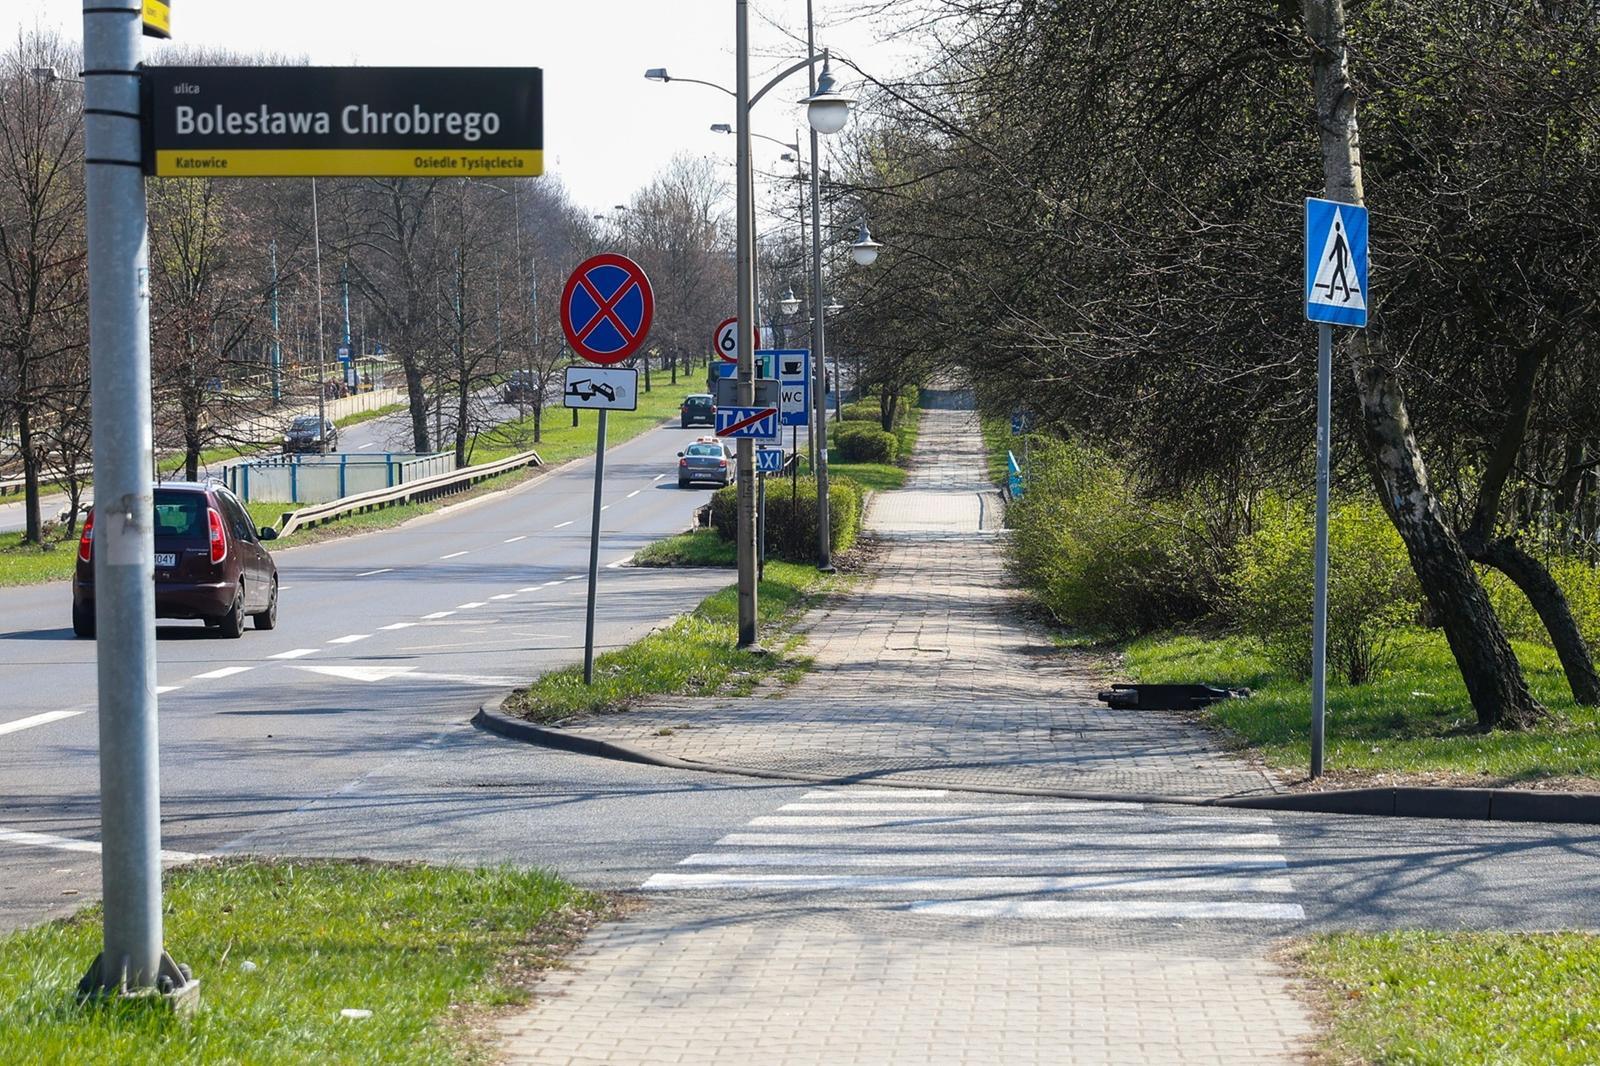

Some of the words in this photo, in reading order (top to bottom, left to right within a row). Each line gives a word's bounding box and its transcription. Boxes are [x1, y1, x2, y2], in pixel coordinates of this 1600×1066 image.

[174, 83, 200, 94] ulica
[176, 104, 330, 135] Bolesława
[341, 104, 500, 141] Chrobrego
[175, 157, 228, 168] Katowice
[414, 156, 457, 168] Osiedle
[461, 156, 524, 171] Tysiąclecia
[721, 329, 736, 351] 6
[782, 391, 802, 403] WC
[718, 410, 773, 434] TAXI
[755, 452, 779, 469] AXI
